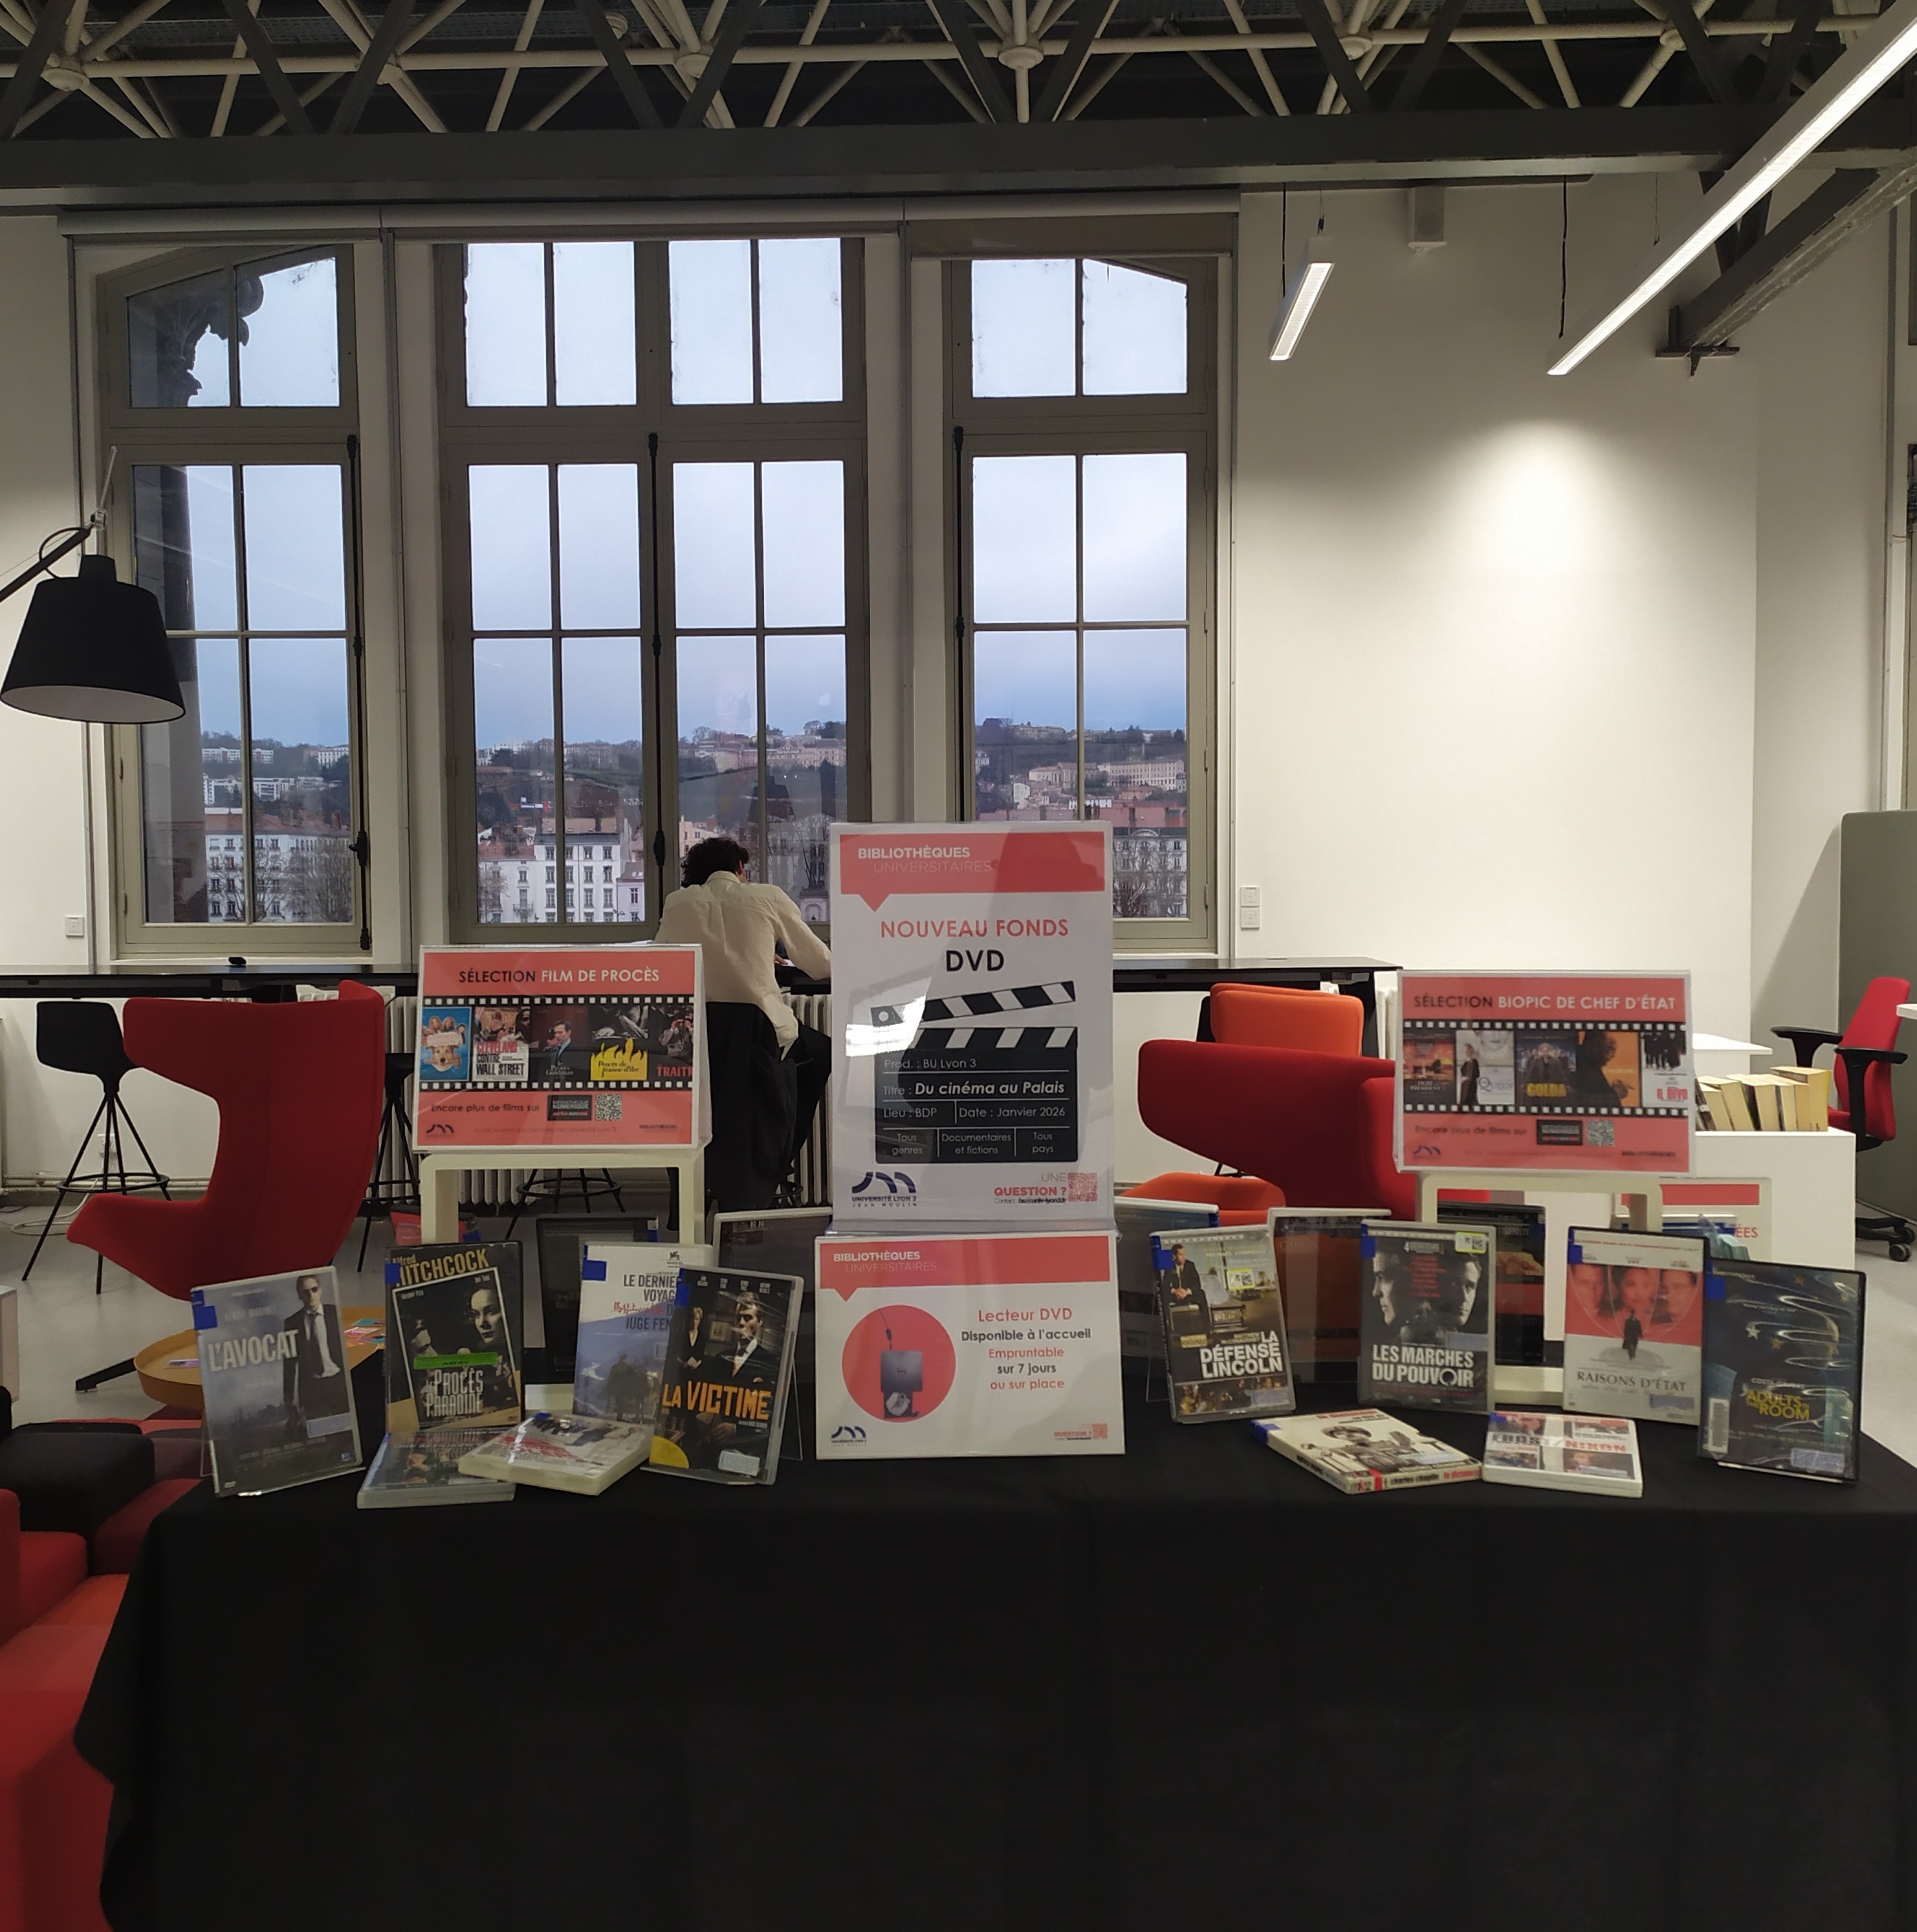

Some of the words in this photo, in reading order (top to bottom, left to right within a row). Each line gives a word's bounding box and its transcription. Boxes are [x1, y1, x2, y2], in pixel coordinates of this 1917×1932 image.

[858, 844, 970, 859] BIBLIOTHÈQUES
[873, 860, 992, 874] UNIVERSITAIRES
[881, 919, 988, 938] NOUVEAU
[996, 918, 1069, 937] FONDS
[946, 950, 1005, 972] DVD
[459, 968, 536, 983] SÉLECTION
[541, 969, 573, 982] FILM
[578, 969, 597, 982] DE
[601, 965, 660, 982] PROCÈS
[1414, 993, 1493, 1007] SÉLECTION
[1498, 996, 1551, 1009] BIOPIC
[1556, 996, 1576, 1009] DE
[1581, 996, 1620, 1009] CHEF
[1625, 994, 1676, 1010] D'ÉTAT
[476, 1040, 517, 1053] CLEVELAND
[476, 1053, 500, 1063] CONTRE
[884, 1059, 913, 1068] Prod.
[923, 1059, 937, 1068] BU
[940, 1059, 967, 1070] Lyon
[969, 1059, 977, 1068] 3
[476, 1063, 496, 1075] WALL
[498, 1063, 525, 1075] STREET
[883, 1086, 905, 1095] Titre
[915, 1082, 934, 1095] Du
[939, 1081, 995, 1095] cinéma
[999, 1084, 1018, 1094] au
[1022, 1081, 1065, 1093] Palais
[1526, 1082, 1567, 1097] GOLDA
[466, 1104, 485, 1113] plus
[884, 1108, 906, 1118] Lieu
[915, 1108, 937, 1117] BDP
[959, 1108, 987, 1117] Date
[996, 1107, 1036, 1117] Janvier
[1040, 1106, 1066, 1117] 2026
[897, 1134, 917, 1142] Tous
[941, 1133, 1011, 1142] Documentaires
[1033, 1132, 1053, 1141] Tous
[892, 1147, 923, 1156] genres
[966, 1145, 998, 1154] fictions
[1031, 1145, 1054, 1154] pays
[1041, 1173, 1067, 1182] UNE
[994, 1187, 1057, 1196] QUESTION
[1060, 1187, 1067, 1196] ?
[833, 1249, 921, 1262] BIBLIOTHÈQUES
[846, 1261, 937, 1273] UNIVERSITAIRES
[623, 1274, 635, 1287] LE
[638, 1274, 679, 1288] DERNIE
[978, 1309, 1035, 1322] Lecteur
[1040, 1308, 1072, 1321] DVD
[625, 1317, 650, 1330] JUGE
[961, 1330, 1024, 1343] Disponible
[1027, 1328, 1035, 1340] à
[1038, 1328, 1091, 1340] l'accueil
[1261, 1330, 1279, 1343] LA
[208, 1329, 299, 1372] L'AVOCAT
[989, 1346, 1064, 1360] Empruntable
[1200, 1343, 1282, 1363] DÉFENSE
[1372, 1344, 1399, 1363] LES
[1401, 1346, 1474, 1368] MARCHES
[997, 1365, 1014, 1374] sur
[1018, 1363, 1024, 1374] 7
[1027, 1363, 1057, 1376] jours
[1201, 1357, 1284, 1379] LINCOLN
[1372, 1362, 1394, 1381] DU
[1397, 1365, 1474, 1388] POUVOIR
[1577, 1370, 1636, 1387] RAISONS
[990, 1381, 1005, 1390] ou
[1009, 1381, 1025, 1390] sur
[1030, 1379, 1065, 1390] place
[425, 1392, 482, 1417] PARADINE
[662, 1383, 681, 1408] LA
[687, 1380, 772, 1421] VICTIME
[1747, 1389, 1802, 1408] ADULTS
[1759, 1403, 1810, 1421] ROOM
[1565, 1440, 1627, 1453] NIXON
